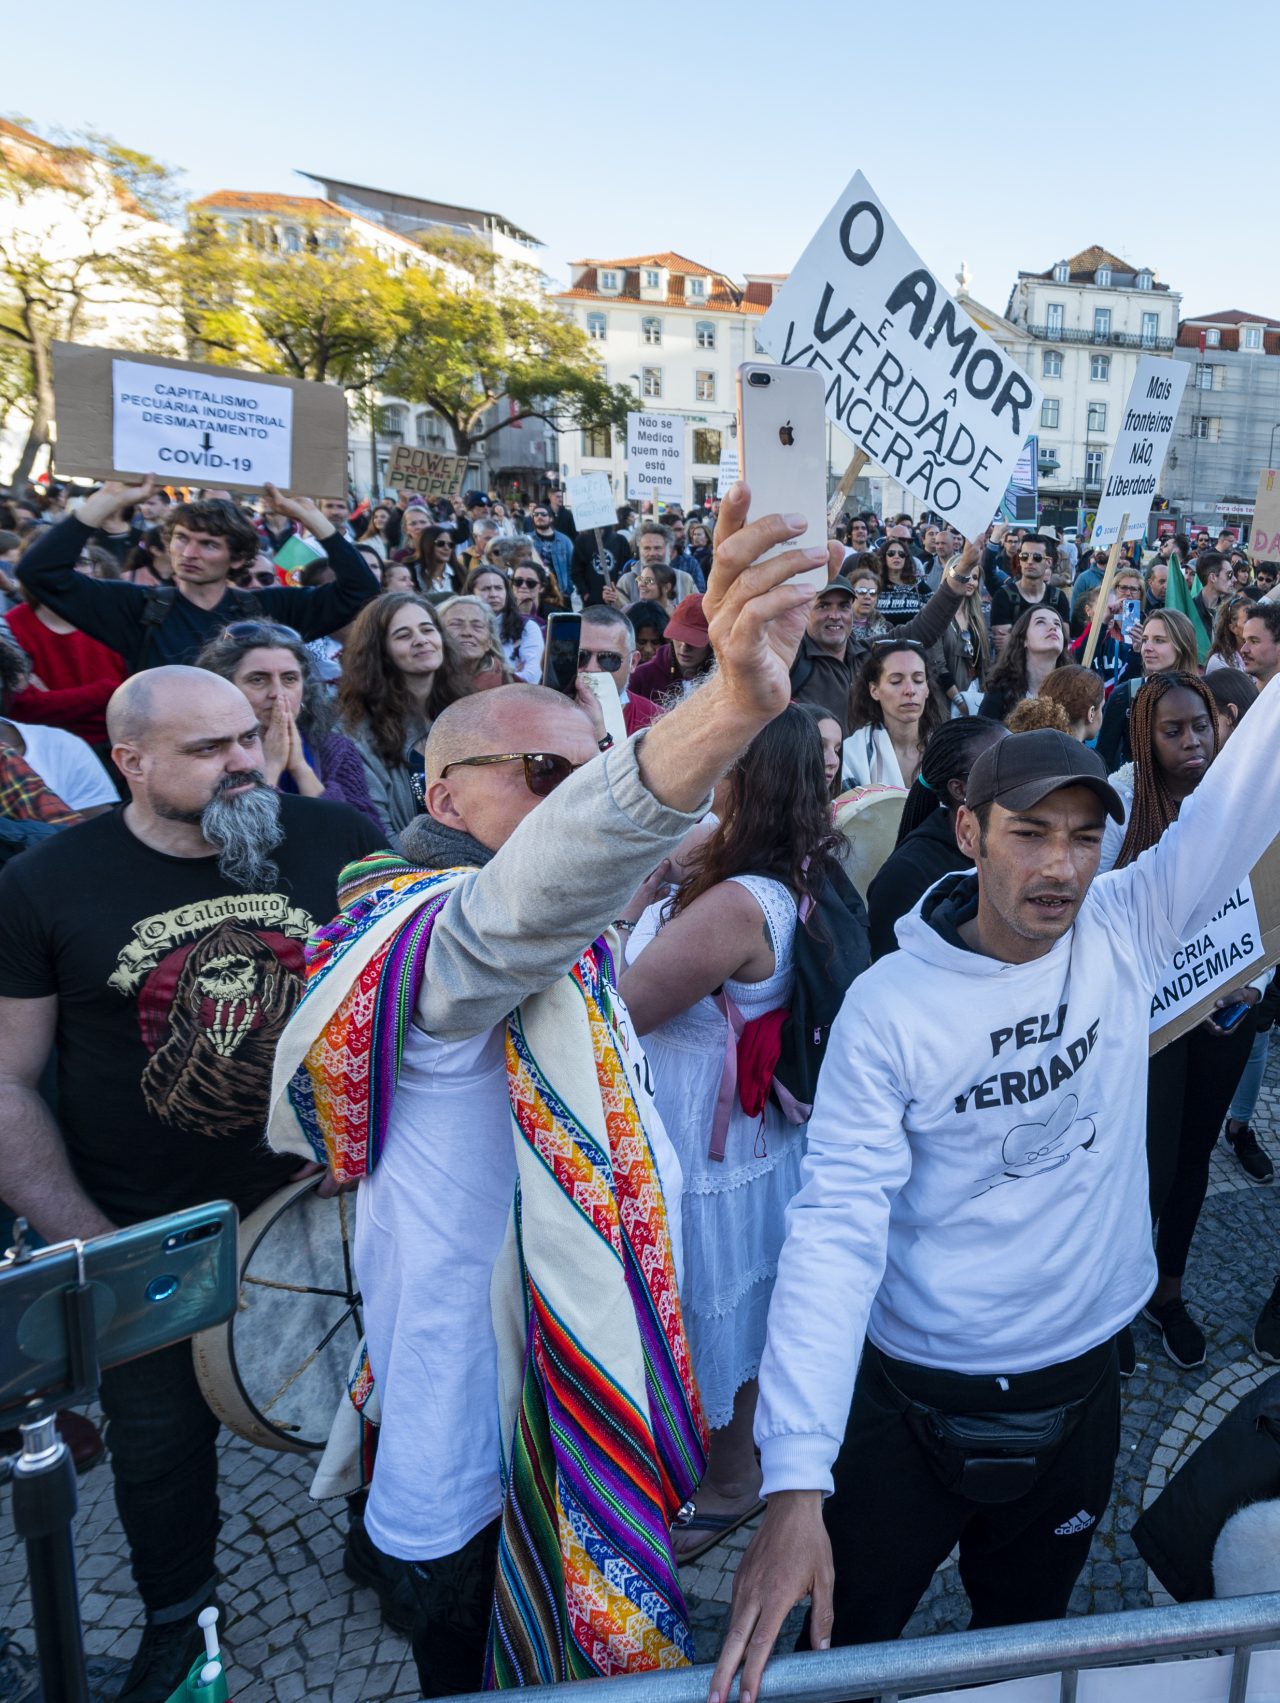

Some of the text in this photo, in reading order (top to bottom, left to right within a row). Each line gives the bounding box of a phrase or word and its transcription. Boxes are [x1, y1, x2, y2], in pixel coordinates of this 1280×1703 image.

[839, 200, 1032, 435] O AMOR
[154, 383, 258, 410] CAPITALISMO
[813, 281, 1003, 492] VERDADE
[943, 387, 958, 407] A
[1146, 376, 1172, 400] Mais
[121, 393, 286, 428] PECUÁRIA INDUSTRIAL
[639, 417, 657, 427] Não
[661, 420, 672, 428] se
[1124, 409, 1173, 432] fronteiras
[142, 411, 268, 439] DESMATAMENTO
[638, 431, 672, 443] Medica
[158, 447, 253, 471] COVID-19
[395, 446, 467, 474] POWER
[631, 446, 679, 457] quem não
[1129, 438, 1153, 466] NÃO,
[645, 461, 665, 470] está
[389, 471, 459, 495] PEOPLE
[639, 473, 672, 485] Doente
[1105, 474, 1156, 497] Liberdade
[144, 898, 280, 938] O Calabouço
[1173, 934, 1215, 970] CRIA
[1151, 933, 1254, 1018] ANDEMIAS
